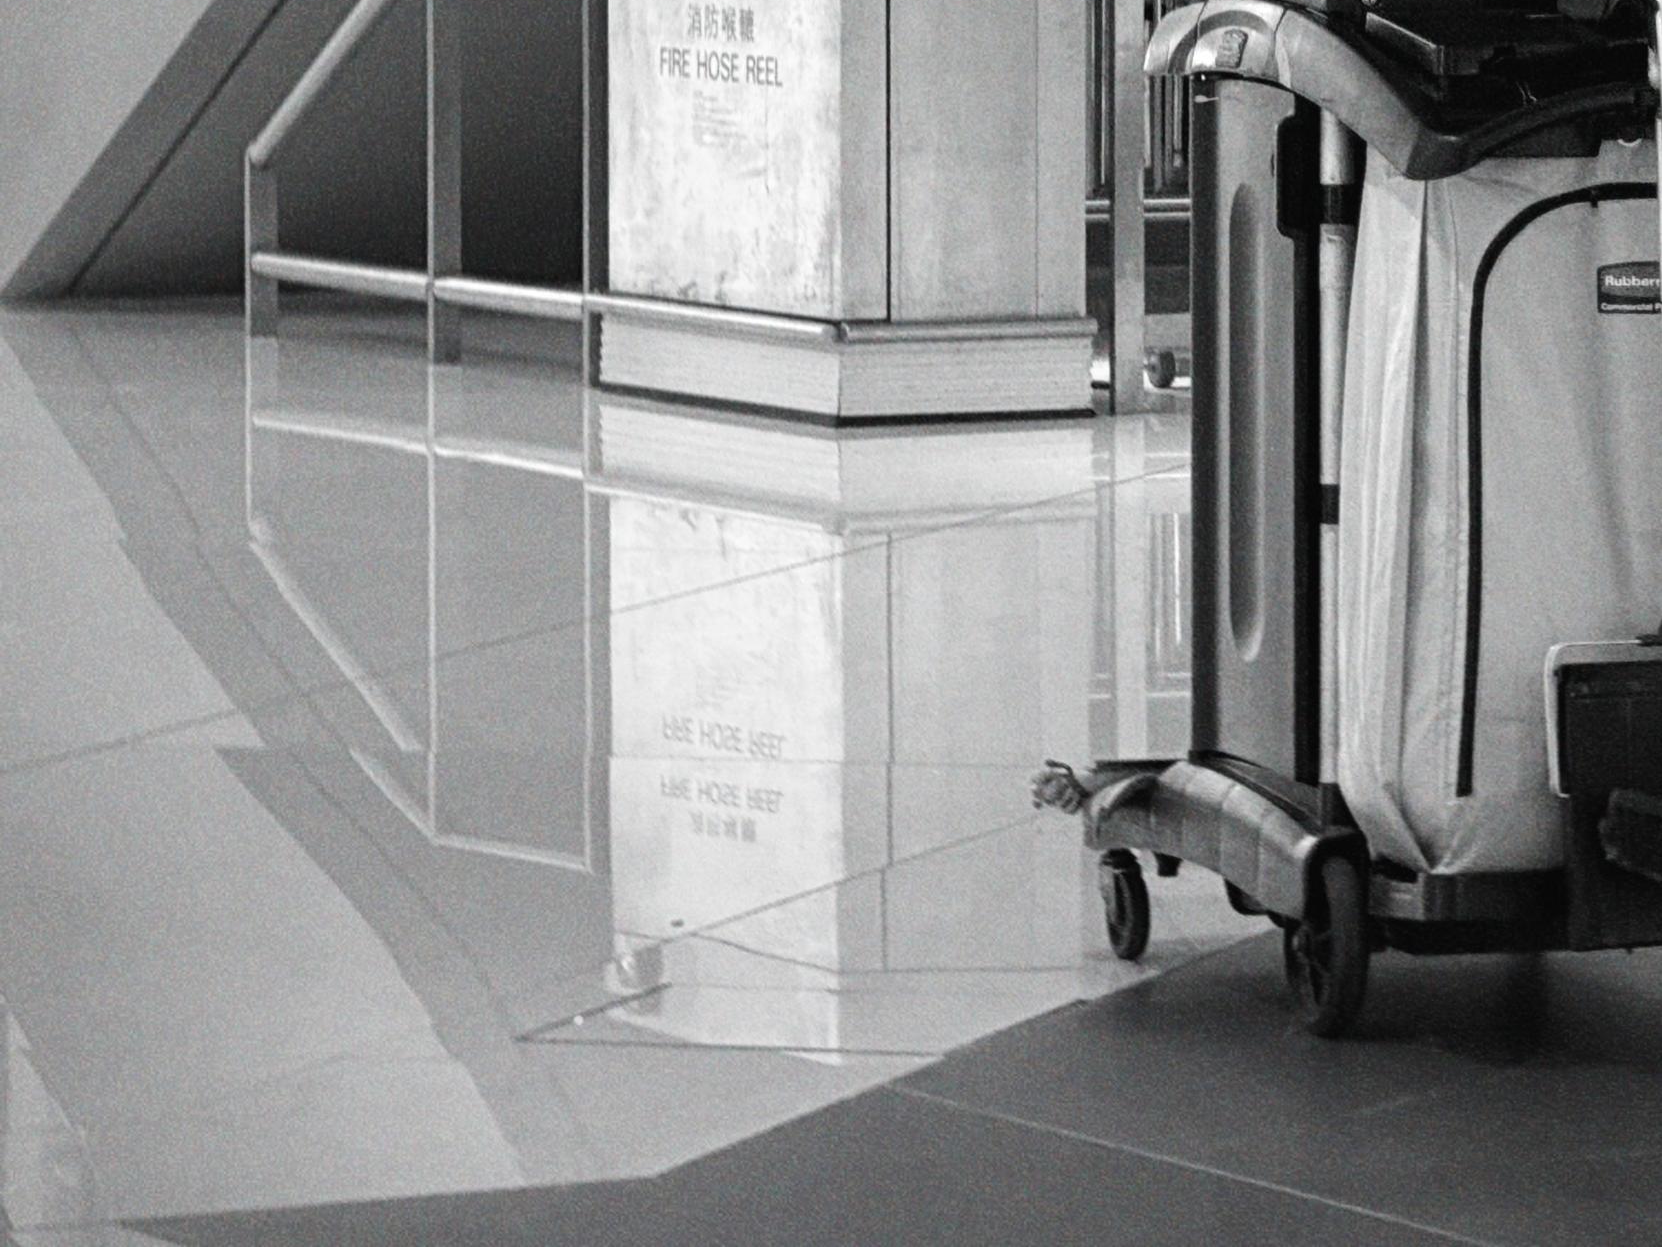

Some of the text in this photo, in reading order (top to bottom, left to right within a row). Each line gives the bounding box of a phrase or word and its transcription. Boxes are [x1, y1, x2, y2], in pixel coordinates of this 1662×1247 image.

[659, 46, 783, 87] FIRE HOSE REEL
